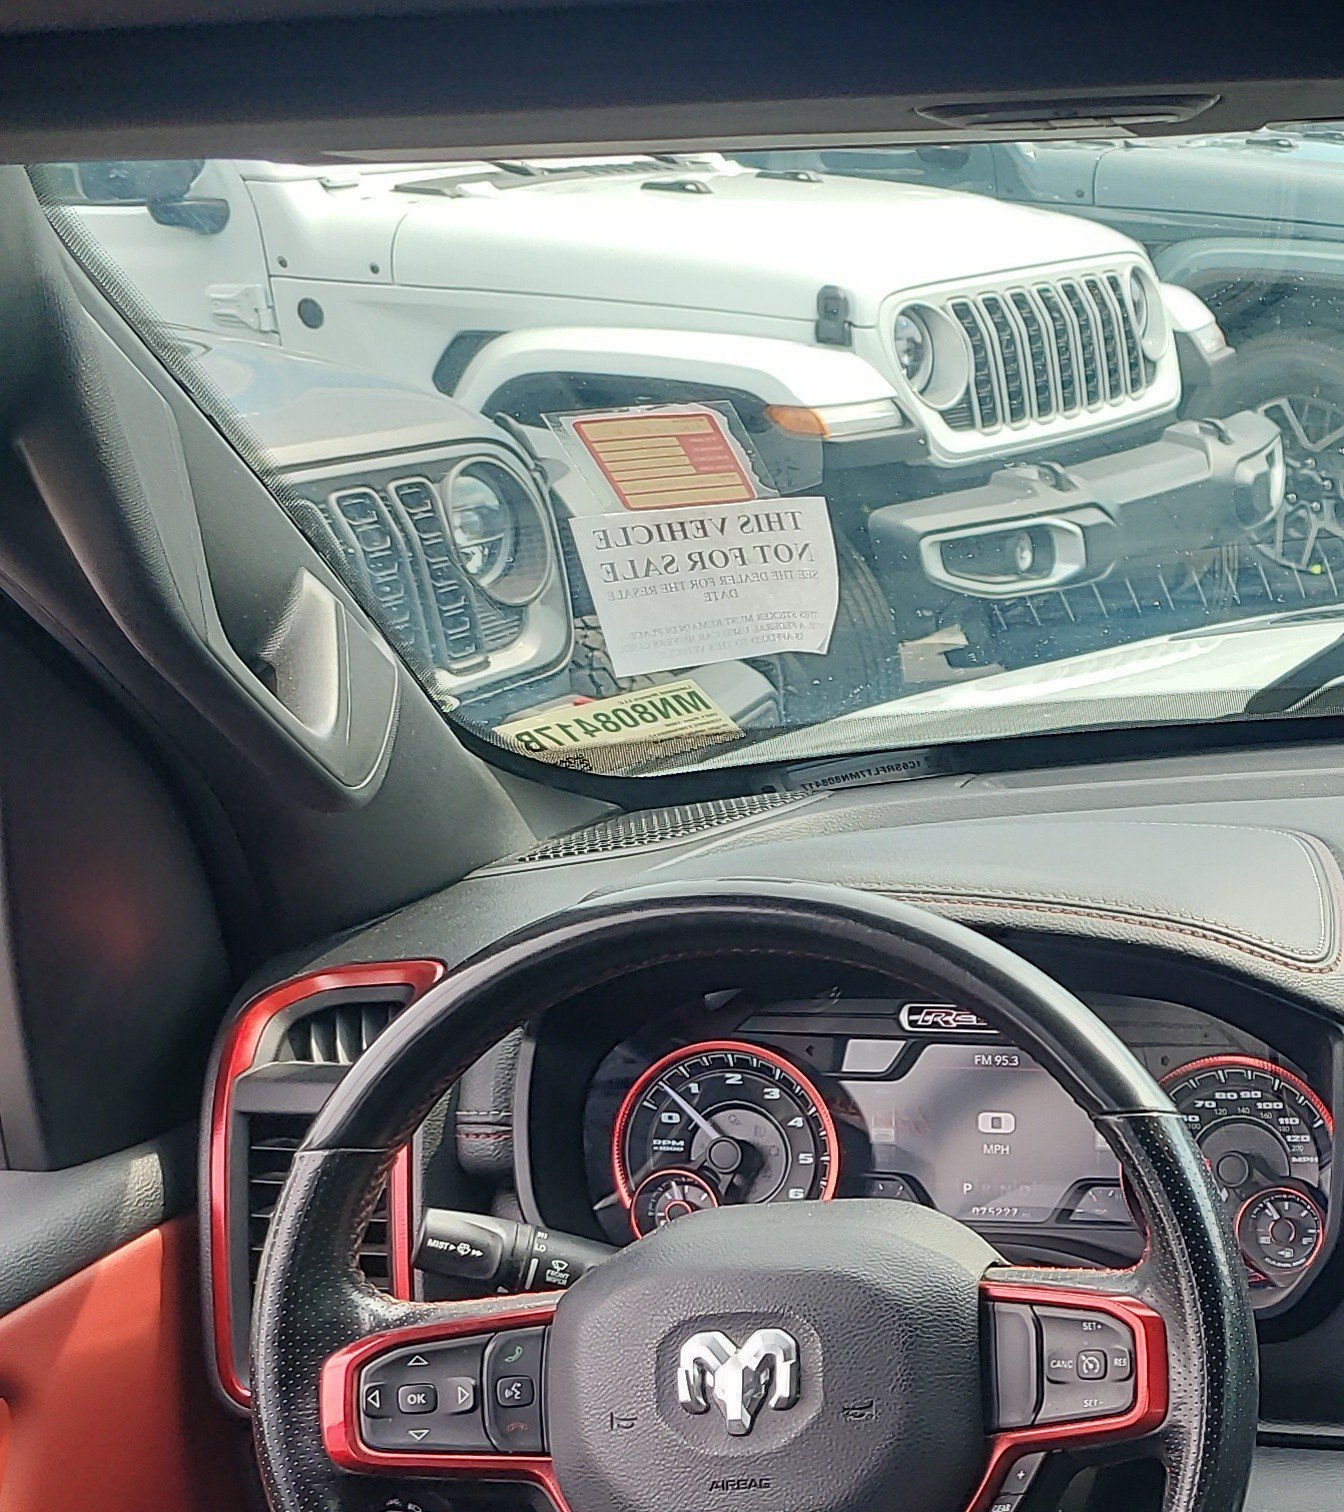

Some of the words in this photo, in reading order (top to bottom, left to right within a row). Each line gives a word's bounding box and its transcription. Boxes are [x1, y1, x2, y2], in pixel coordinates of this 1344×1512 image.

[974, 1055, 992, 1065] FM
[995, 1055, 1019, 1066] 95.3
[725, 1073, 743, 1084] 2
[689, 1083, 700, 1094] 1
[763, 1088, 781, 1099] 3
[1194, 1100, 1216, 1108] 70
[661, 1112, 681, 1124] 0
[787, 1117, 804, 1128] 4
[977, 1112, 1016, 1134] 0
[1279, 1117, 1299, 1125] 110
[983, 1144, 1010, 1154] MPH
[798, 1154, 814, 1164] 5
[789, 1188, 804, 1199] 6
[963, 1183, 973, 1194] P
[427, 1238, 450, 1252] MIST
[535, 1243, 547, 1252] LO
[1050, 1360, 1074, 1368] CANC
[1114, 1358, 1127, 1367] RES
[407, 1392, 426, 1406] OK
[708, 1478, 771, 1490] AIRBAG
[992, 1504, 1011, 1512] GEAR
